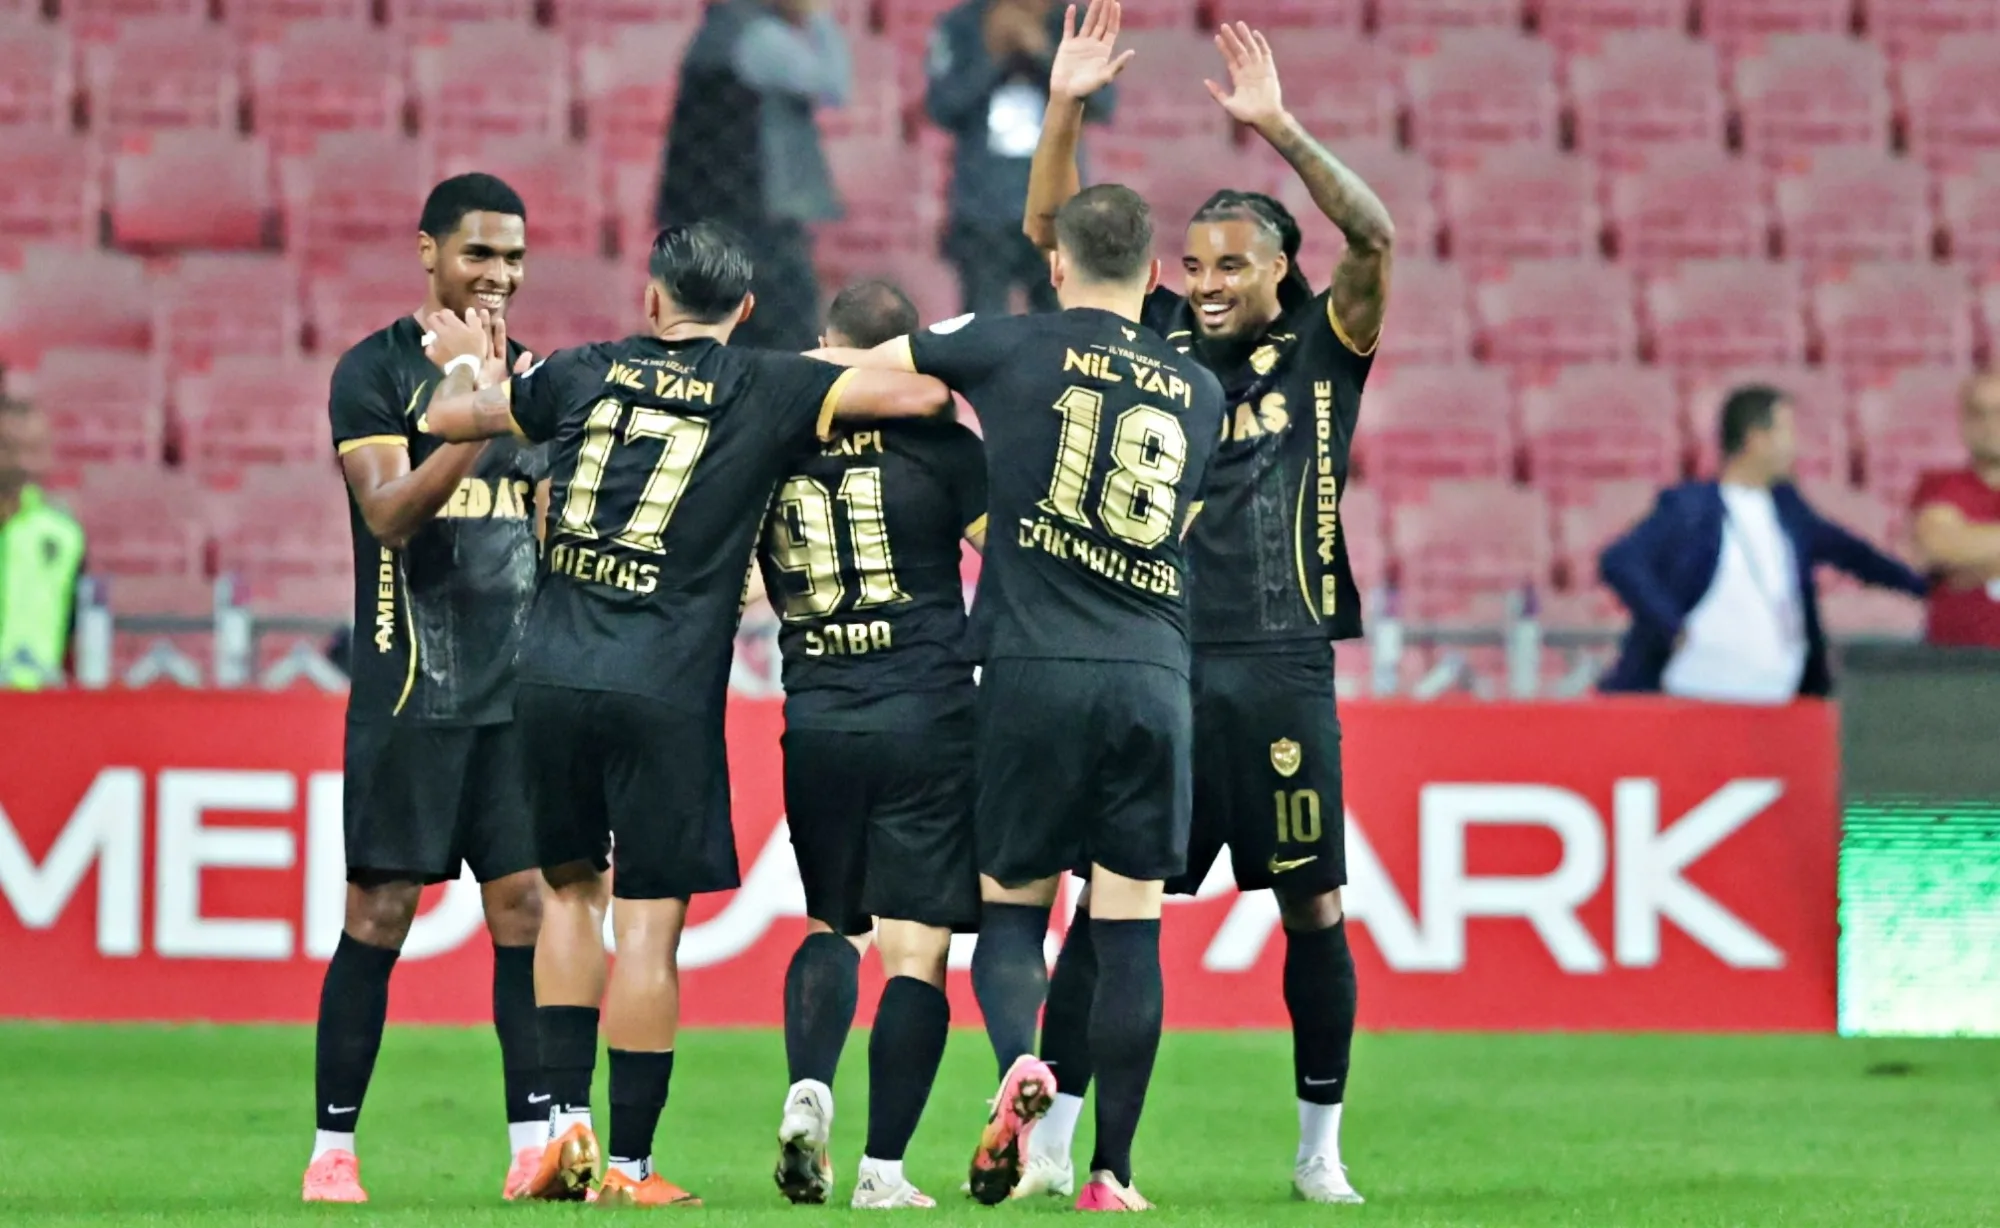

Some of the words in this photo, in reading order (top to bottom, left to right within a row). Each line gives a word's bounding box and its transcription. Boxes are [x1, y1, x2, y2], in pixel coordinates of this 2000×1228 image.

[655, 369, 714, 405] YAPI
[1130, 362, 1191, 409] YAPI
[820, 430, 884, 456] API
[1035, 385, 1187, 549] 18
[556, 397, 710, 555] 17
[771, 467, 913, 621] 91
[805, 620, 892, 656] SABA
[1274, 789, 1321, 842] 10
